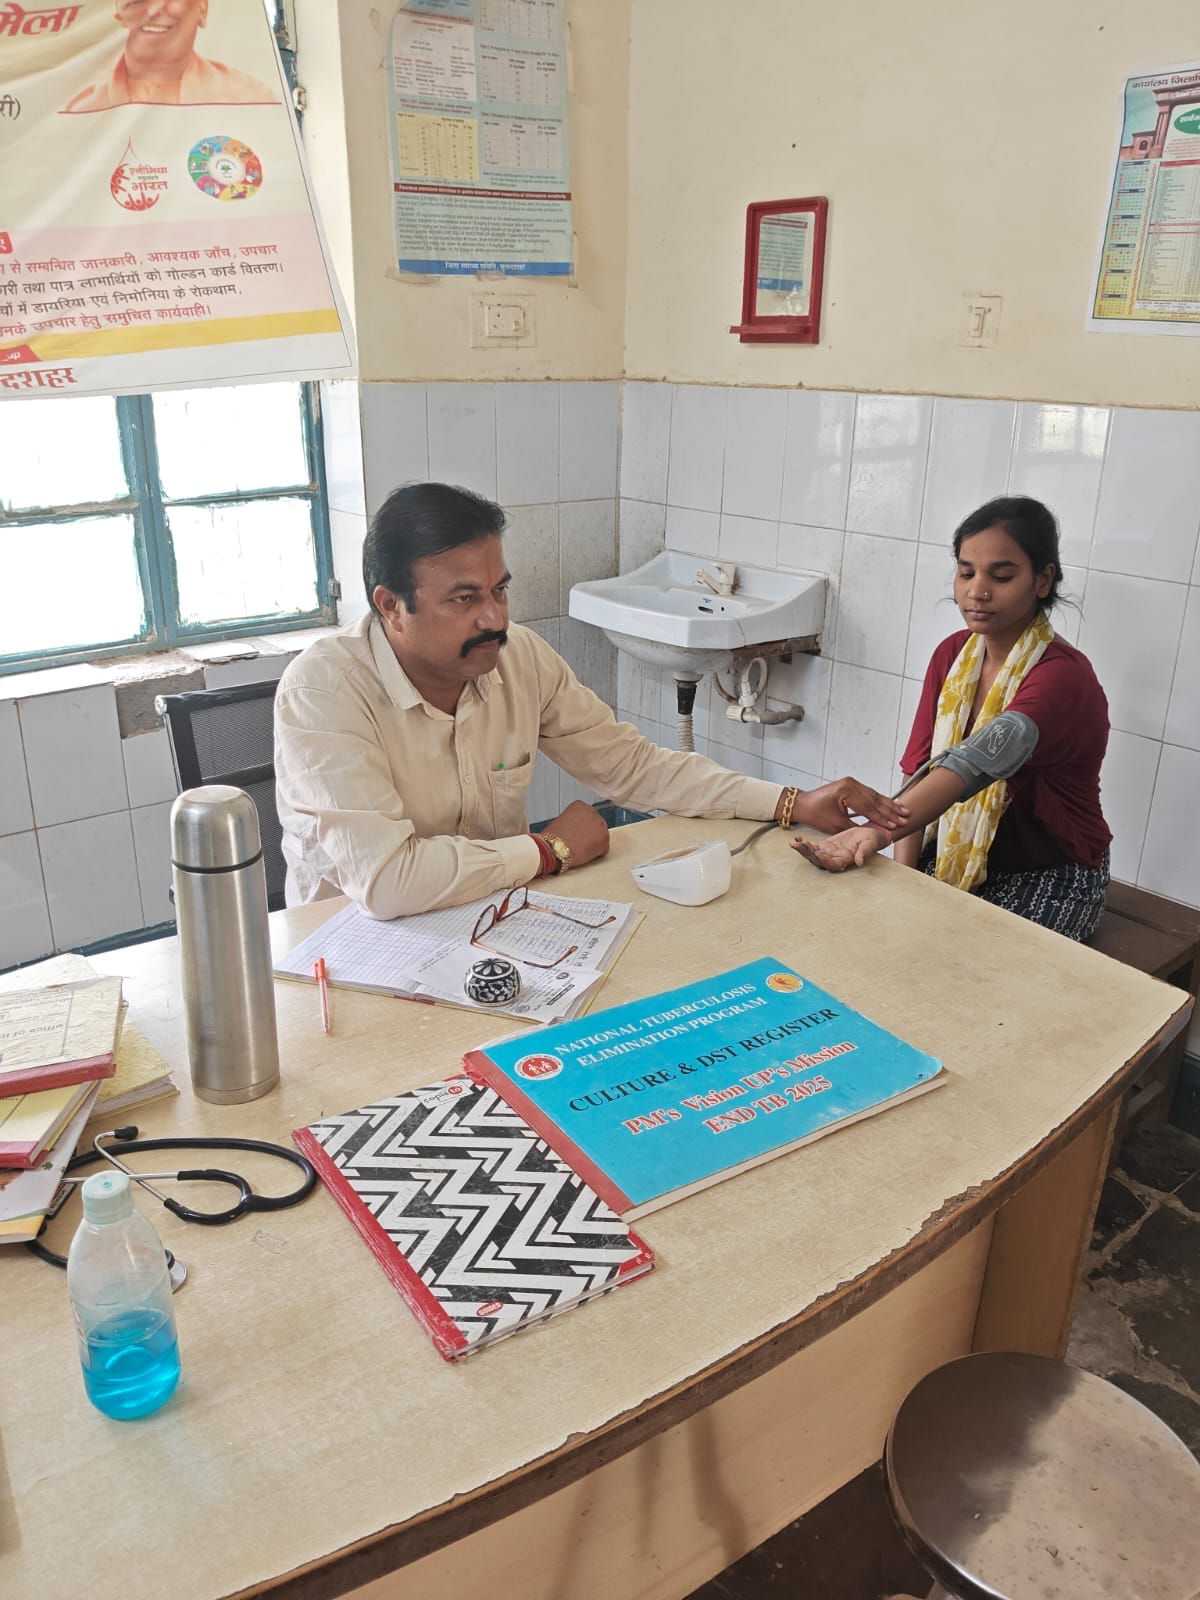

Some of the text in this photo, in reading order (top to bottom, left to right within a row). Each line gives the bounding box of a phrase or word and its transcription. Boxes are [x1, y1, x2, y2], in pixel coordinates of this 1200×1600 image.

[131, 181, 168, 191] भारत
[147, 250, 200, 263] आवश्यक
[240, 244, 278, 257] उपचार
[16, 300, 27, 315] में
[31, 297, 86, 313] डायरिया
[89, 292, 109, 307] एवं
[112, 287, 170, 304] निमोनिया
[172, 285, 186, 299] के
[22, 281, 45, 294] तथा
[49, 280, 75, 292] पात्र
[144, 268, 162, 281] को
[165, 267, 206, 281] गोल्डन
[209, 262, 237, 277] कार्ड
[31, 317, 76, 331] उपचार
[79, 312, 102, 329] हेतु
[104, 308, 152, 325] समुचित
[554, 983, 757, 1055] NATIONAL TUBERCULOSIS
[576, 996, 768, 1066] ELIMINATION PROGRAM
[569, 1008, 840, 1111] CULTURE & DST REGISTER
[621, 1041, 858, 1135] PM's Vision UP's Mission
[702, 1075, 832, 1135] END TB 2025
